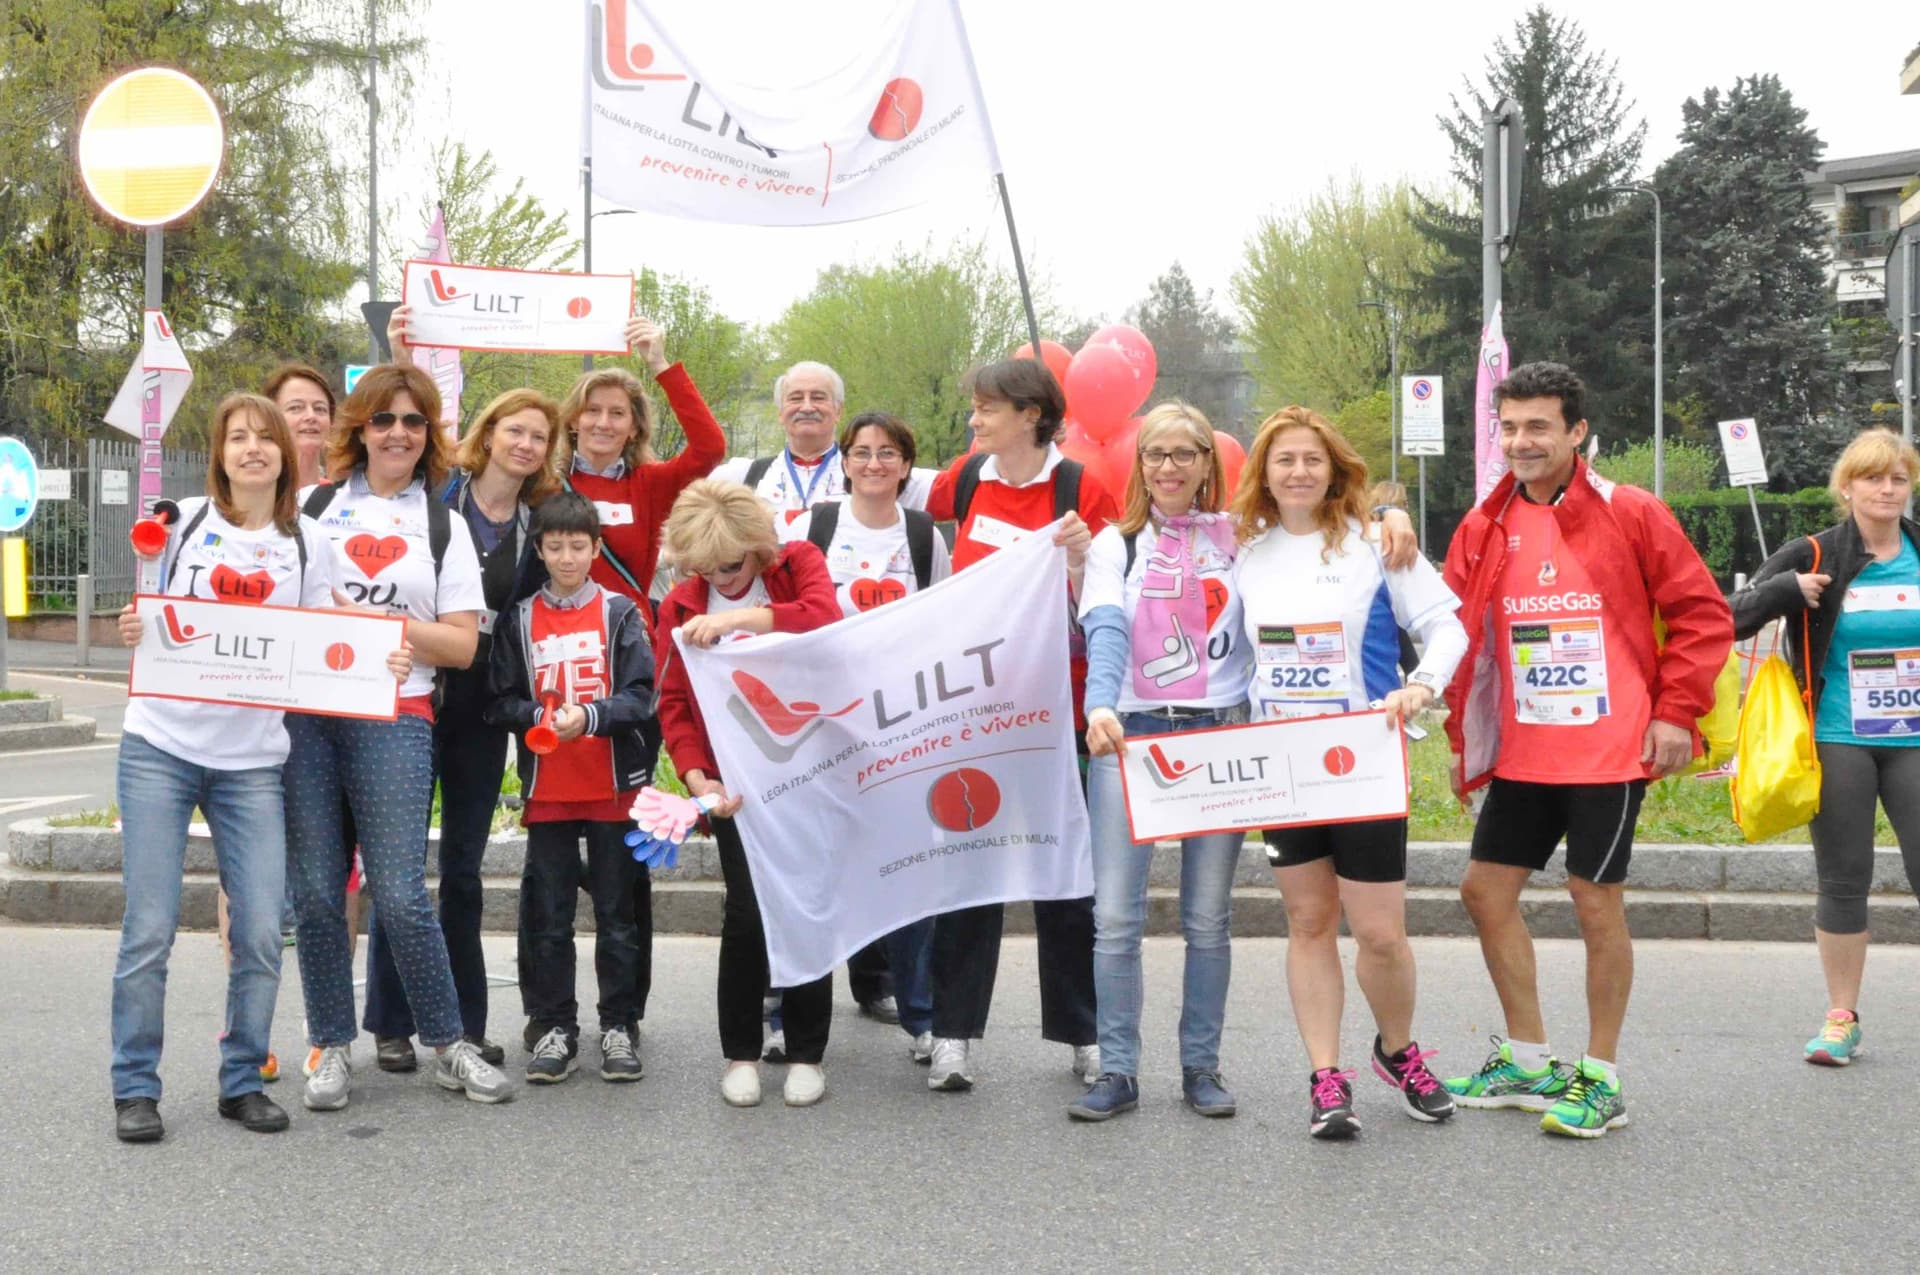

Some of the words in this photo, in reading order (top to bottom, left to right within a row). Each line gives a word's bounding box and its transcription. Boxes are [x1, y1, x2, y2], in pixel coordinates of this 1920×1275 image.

[632, 121, 653, 137] PER
[653, 127, 666, 142] LA
[667, 133, 700, 154] LOTTA
[701, 147, 743, 169] CONTRO
[751, 163, 790, 180] TUMORI
[877, 128, 930, 168] PROVINCIALE
[640, 154, 730, 187] prevenire
[755, 178, 816, 196] vivere
[473, 293, 525, 314] LILT
[352, 543, 401, 559] LILT
[183, 564, 206, 598] I
[218, 575, 268, 598] LILT
[858, 589, 901, 607] LILT
[214, 633, 276, 660] LILT
[873, 637, 1006, 730] LILT
[1271, 666, 1331, 688] 522C
[1526, 664, 1588, 687] 422C
[761, 785, 790, 805] LEGA
[790, 758, 835, 788] ITALIANA
[835, 749, 854, 766] PER
[853, 740, 869, 756] LA
[871, 733, 910, 748] LOTTA
[911, 712, 959, 738] CONTRO
[968, 700, 1016, 718] TUMORI
[857, 731, 953, 787] prevenire
[960, 721, 974, 741] è
[980, 709, 1051, 737] vivere
[1207, 756, 1269, 784] LILT
[879, 851, 927, 879] SEZIONE
[928, 835, 1009, 860] PROVINCIALE
[1010, 833, 1023, 846] DI
[1026, 833, 1059, 847] MILAN
